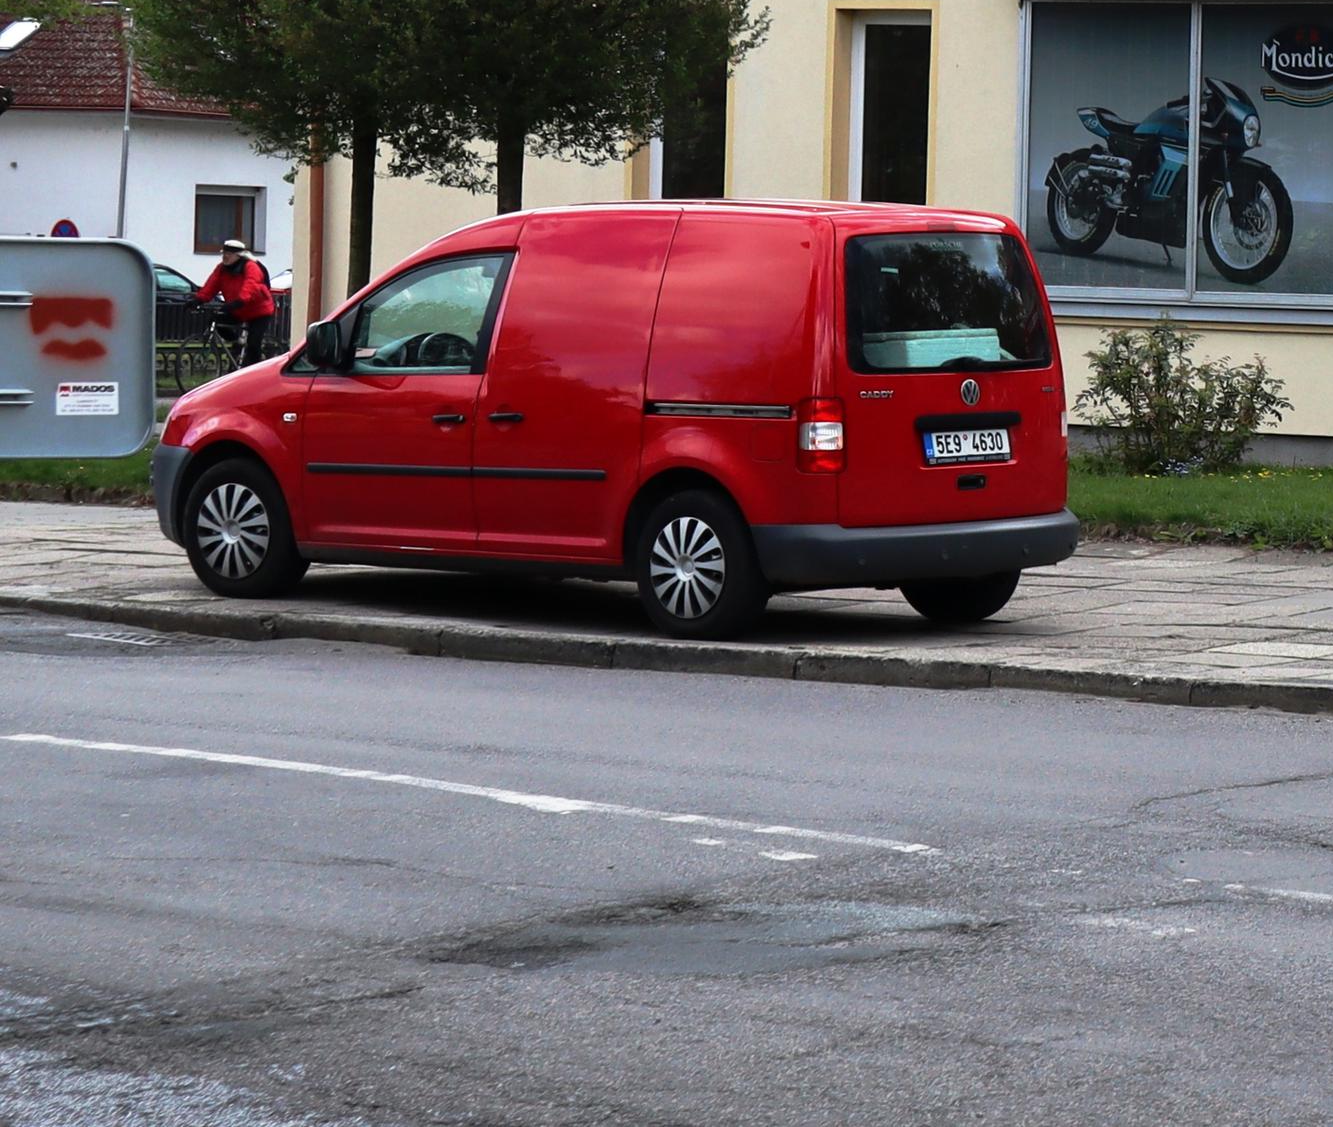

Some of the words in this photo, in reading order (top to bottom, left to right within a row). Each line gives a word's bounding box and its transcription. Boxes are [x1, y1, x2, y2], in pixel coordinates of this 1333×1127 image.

[72, 385, 115, 393] MADOS
[860, 390, 894, 399] CADDY
[936, 434, 962, 454] 5E9
[972, 432, 1004, 453] 4630
